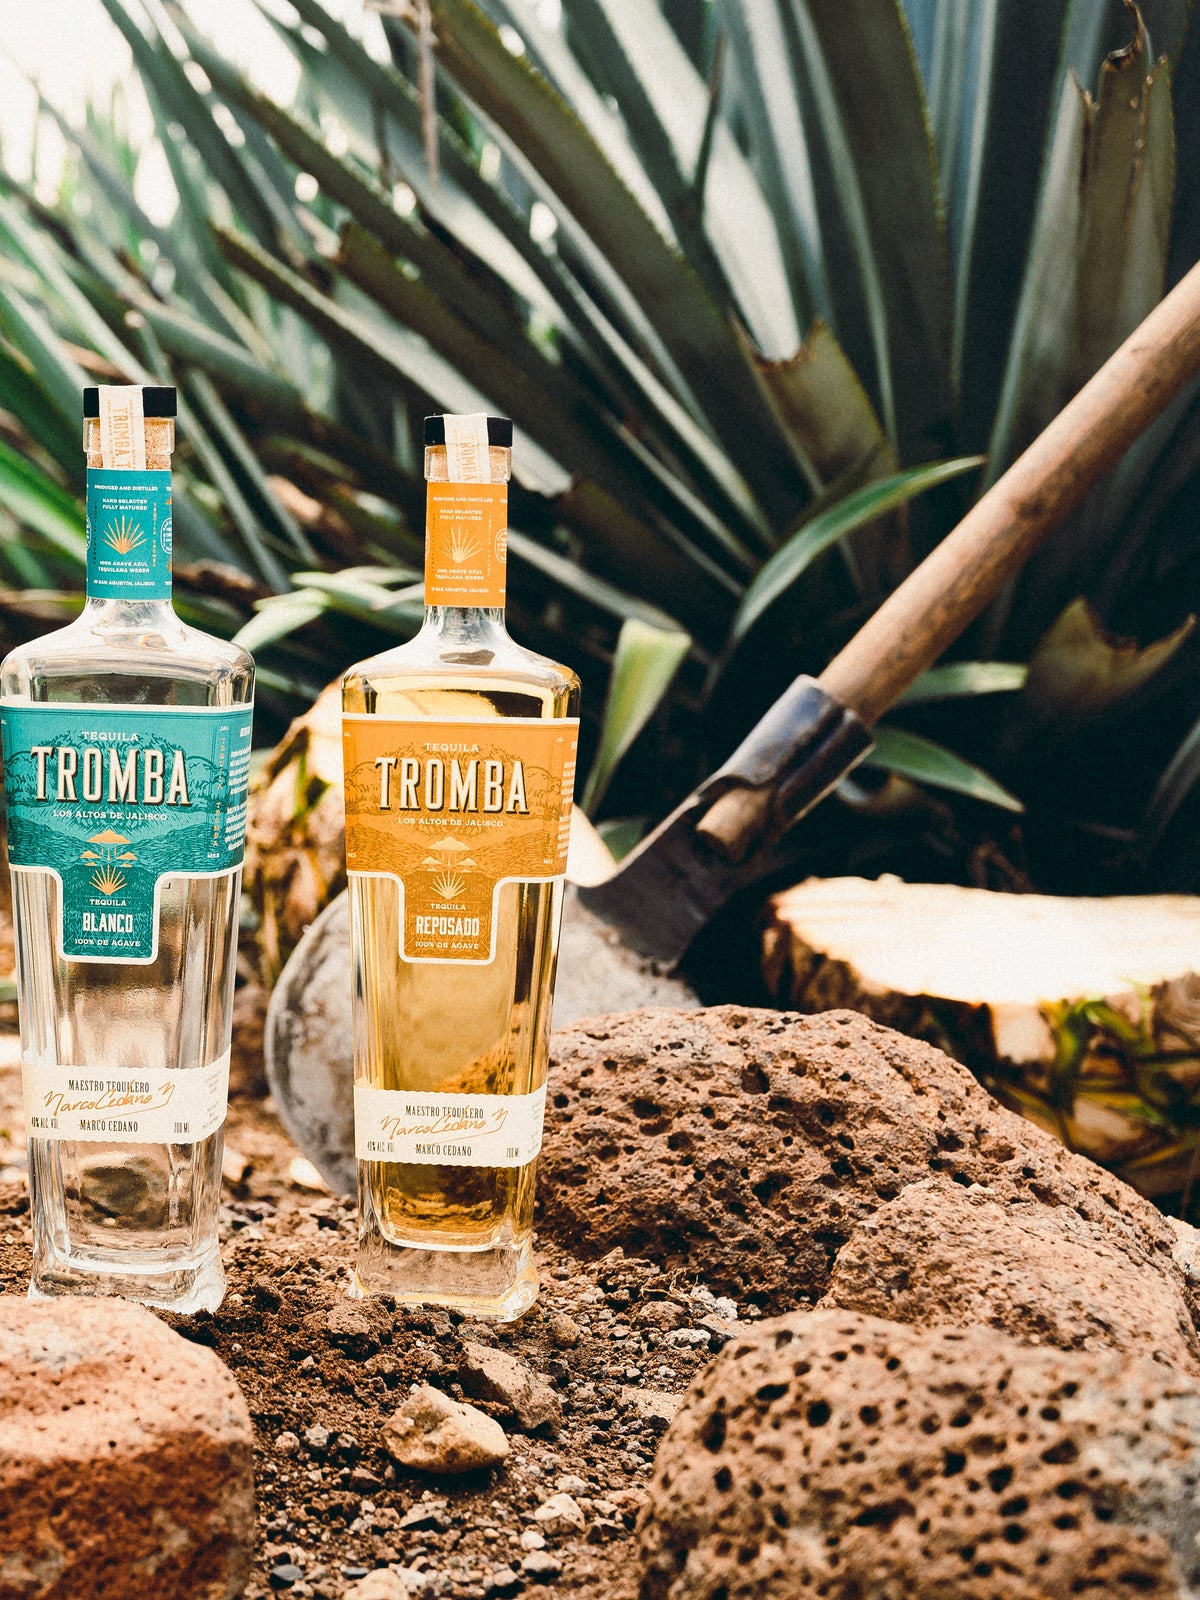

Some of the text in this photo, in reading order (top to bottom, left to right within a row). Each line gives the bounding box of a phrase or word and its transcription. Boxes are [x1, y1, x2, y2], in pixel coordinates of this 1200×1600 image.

[82, 731, 139, 742] TEQUILA
[424, 742, 480, 753] TEQUILA
[217, 737, 226, 790] TEQUILA
[30, 745, 192, 806] TROMBA
[375, 757, 530, 814] TROMBA
[53, 810, 167, 821] LOS ALTOS DE JALISCO
[398, 817, 416, 825] LOS
[418, 818, 448, 826] ALTOS
[465, 819, 504, 827] JALISCO
[212, 801, 221, 847] TROMBA
[82, 912, 133, 933] BLANCO
[416, 916, 480, 936] REPOSADO
[111, 939, 141, 947] AGAVE
[68, 1079, 150, 1093] MAESTRO TEQUILERO
[405, 1105, 484, 1119] MAESTRO TEQUILERO
[79, 1119, 139, 1132] MARCO CEDANO
[415, 1143, 472, 1157] MARCO CEDANO
